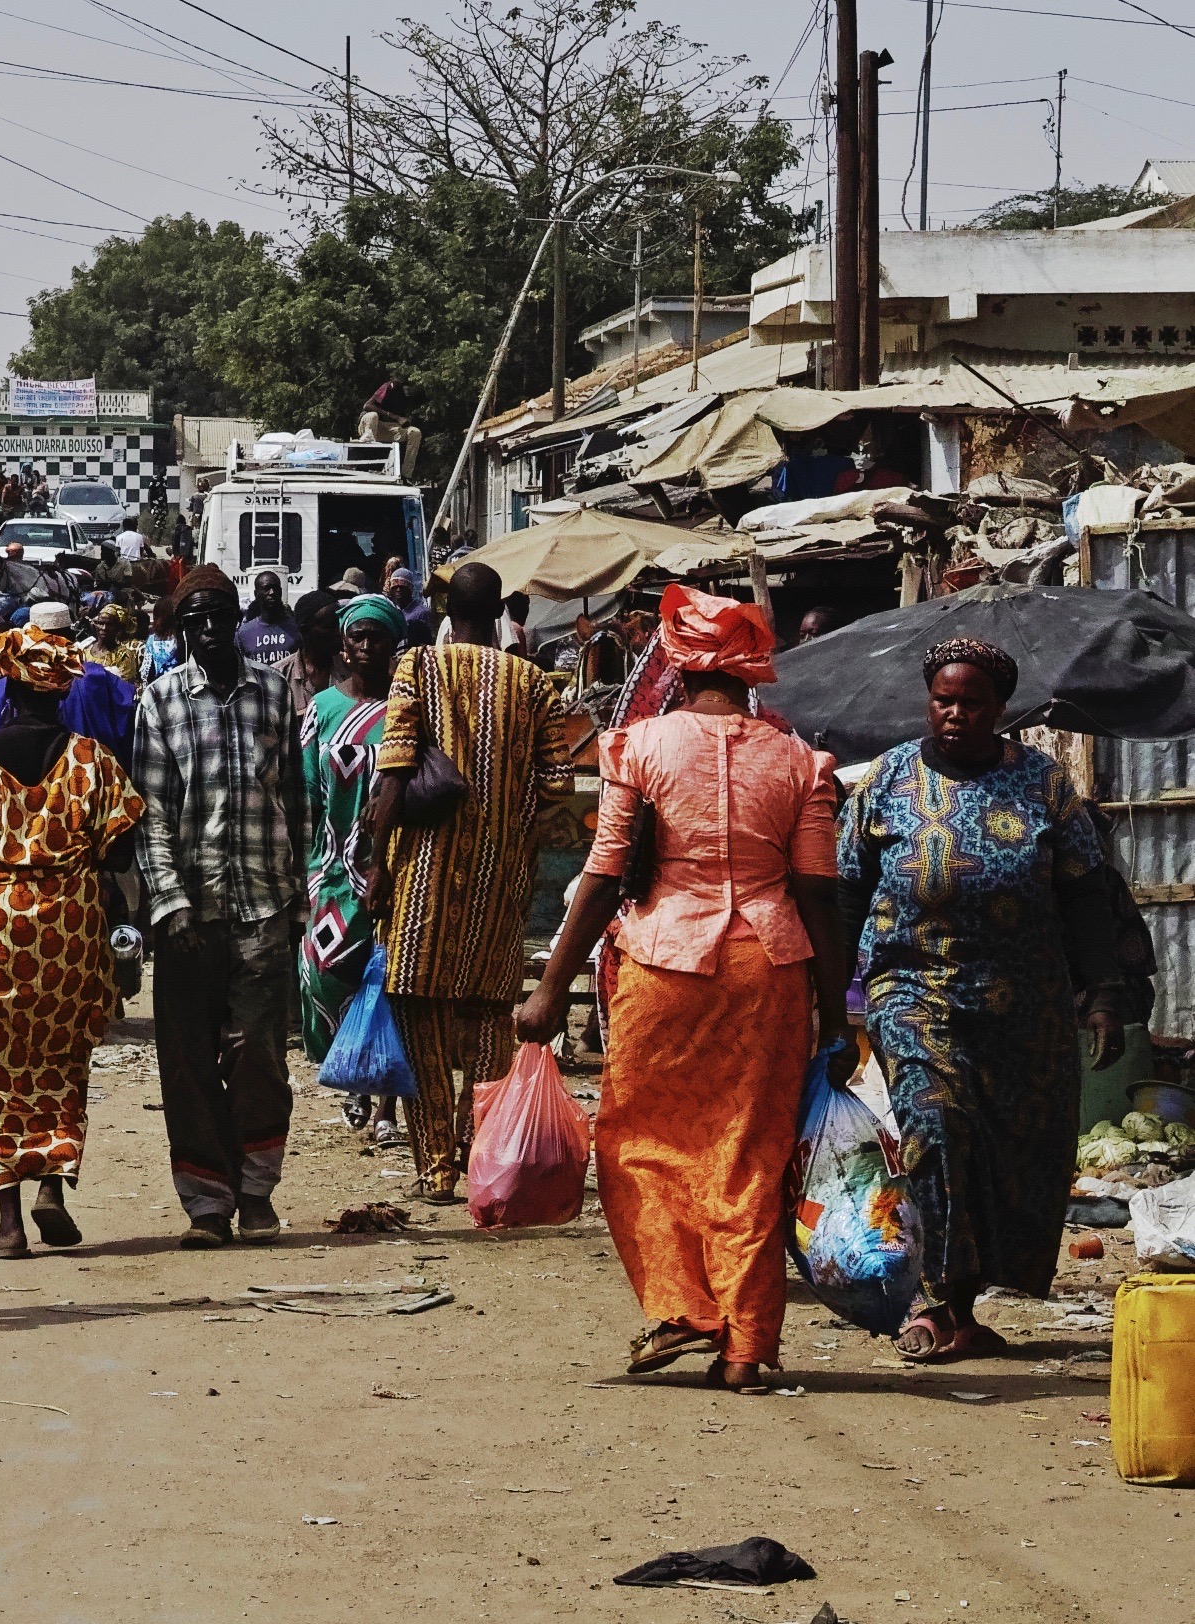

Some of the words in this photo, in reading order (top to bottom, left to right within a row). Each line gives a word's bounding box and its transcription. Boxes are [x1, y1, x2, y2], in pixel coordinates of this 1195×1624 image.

[35, 438, 67, 453] DIARRA
[68, 438, 103, 453] BOUSSO
[244, 495, 292, 506] SANTE
[256, 633, 286, 648] LONG
[253, 650, 291, 664] SLAND
